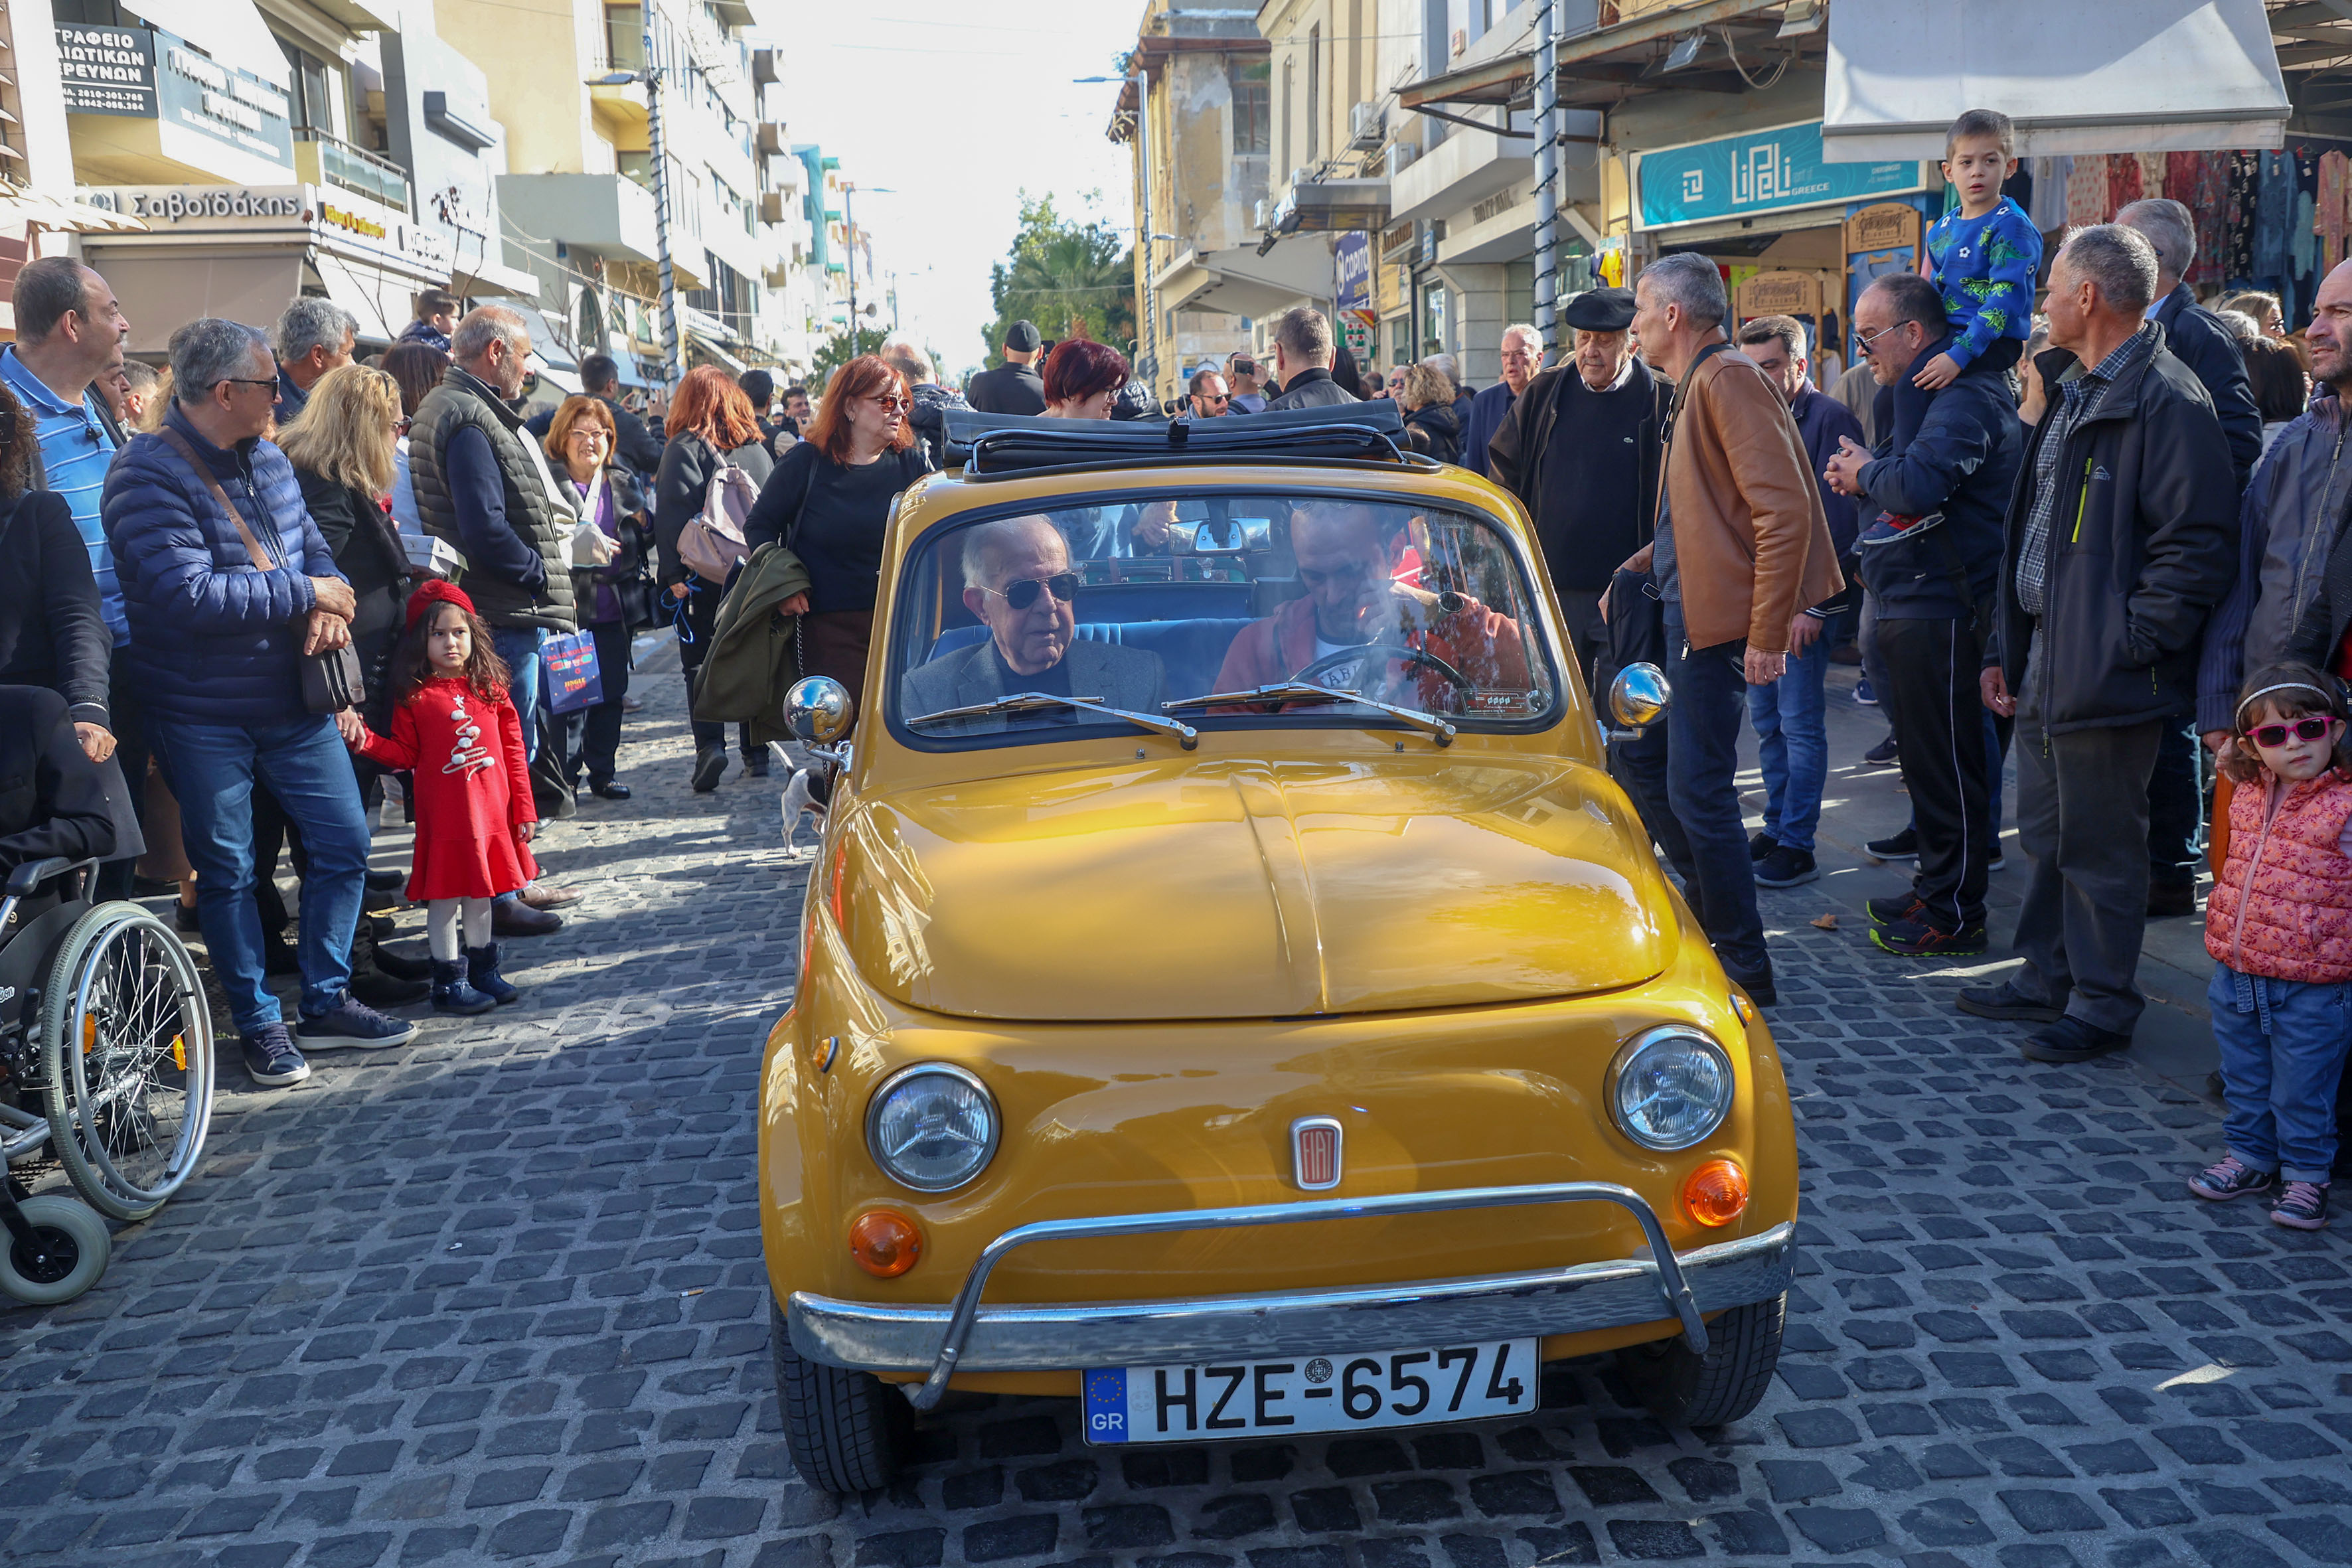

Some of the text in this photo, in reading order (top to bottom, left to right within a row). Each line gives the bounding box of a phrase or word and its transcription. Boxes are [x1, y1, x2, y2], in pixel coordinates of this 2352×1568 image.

[129, 190, 298, 223] Σαβοϊδάκης
[1791, 181, 1830, 196] GREECE
[1302, 1131, 1333, 1180] FIAT
[1092, 1413, 1123, 1430] GR
[1154, 1343, 1524, 1431] HZE-6574
